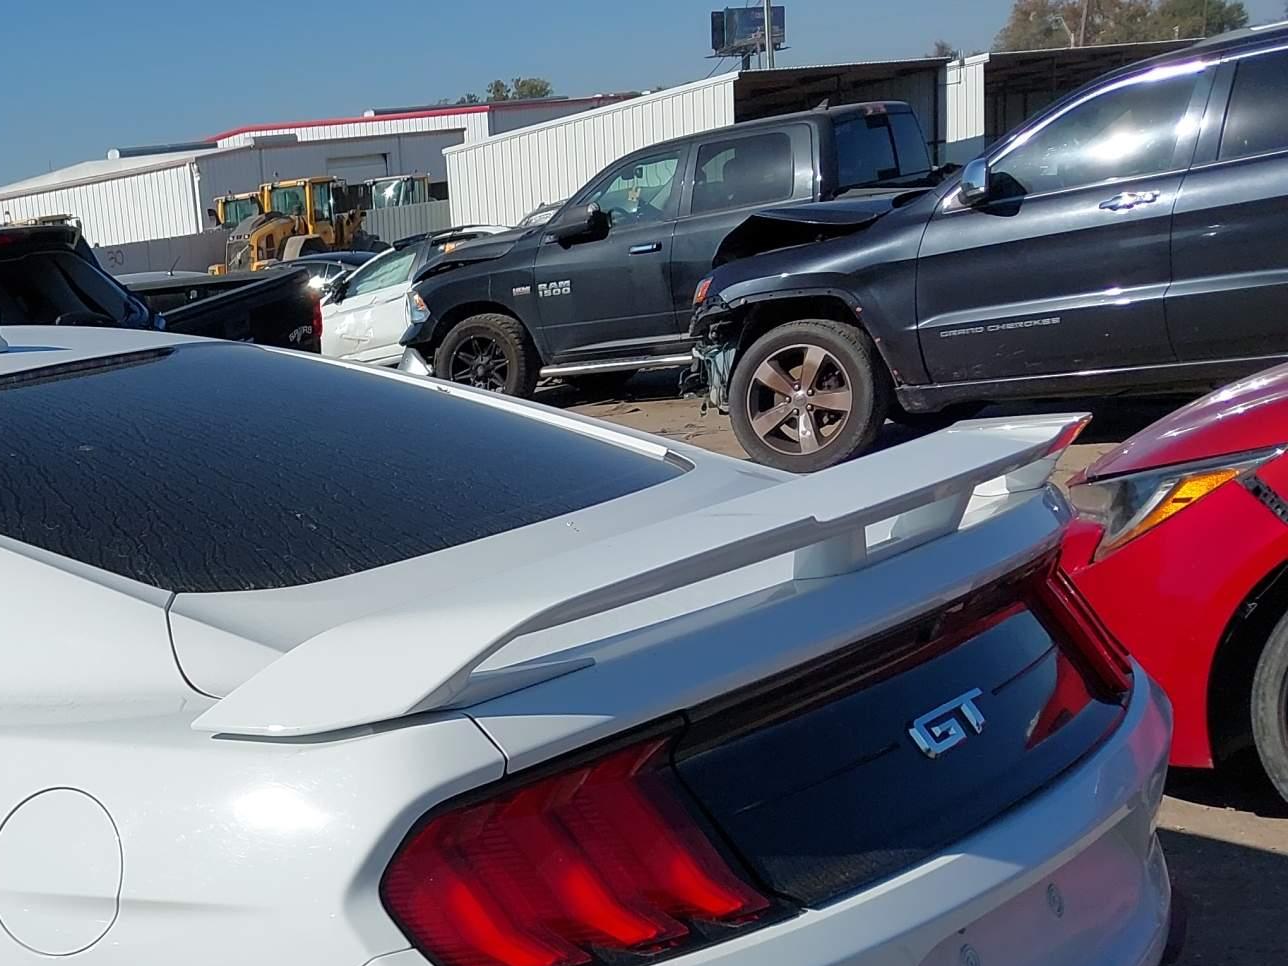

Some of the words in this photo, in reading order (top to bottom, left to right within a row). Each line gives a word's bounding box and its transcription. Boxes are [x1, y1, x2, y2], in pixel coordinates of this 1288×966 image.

[537, 279, 571, 291] RAM
[538, 287, 571, 298] 1500
[939, 326, 985, 338] GRAND
[986, 316, 1061, 332] CHEROKEE
[909, 687, 985, 759] GT
